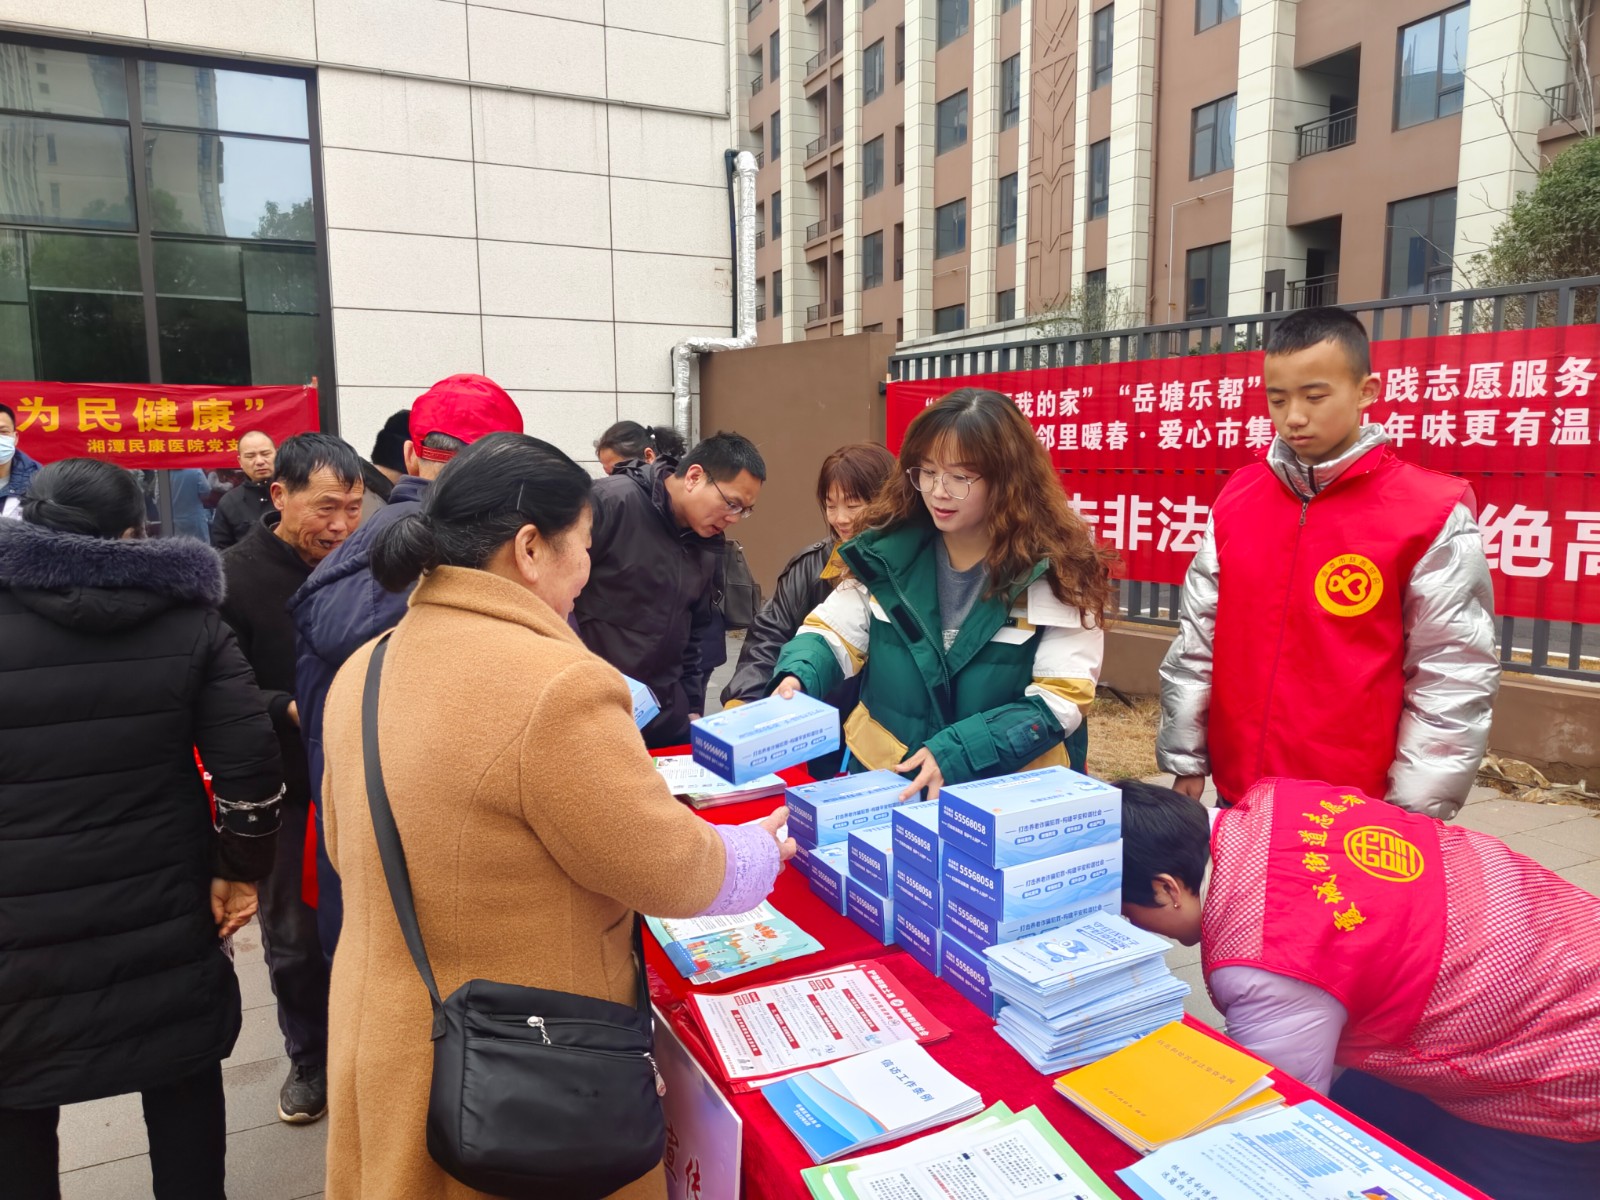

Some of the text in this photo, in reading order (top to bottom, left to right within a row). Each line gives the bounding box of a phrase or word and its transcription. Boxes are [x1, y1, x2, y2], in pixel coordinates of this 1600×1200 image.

[1118, 375, 1262, 413] “岳塘乐帮”
[1372, 356, 1597, 403] 践志愿服务
[16, 397, 264, 432] 为民健康”
[1029, 407, 1600, 450] 邻里暖春·爱心市集 年味更有温
[87, 439, 239, 453] 湘潭民康医院党支
[954, 811, 986, 835] 55568058
[904, 829, 931, 851] 55568058
[858, 851, 881, 871] 55568058
[906, 876, 933, 899] 55568058
[959, 864, 994, 890] 55568058
[856, 891, 879, 917] 55568058
[906, 920, 931, 946] 55568058
[958, 906, 989, 934] 55568058
[955, 956, 986, 985] 55568058
[881, 1058, 935, 1102] 信访工作条例
[1161, 1170, 1201, 1200] 远离非法
